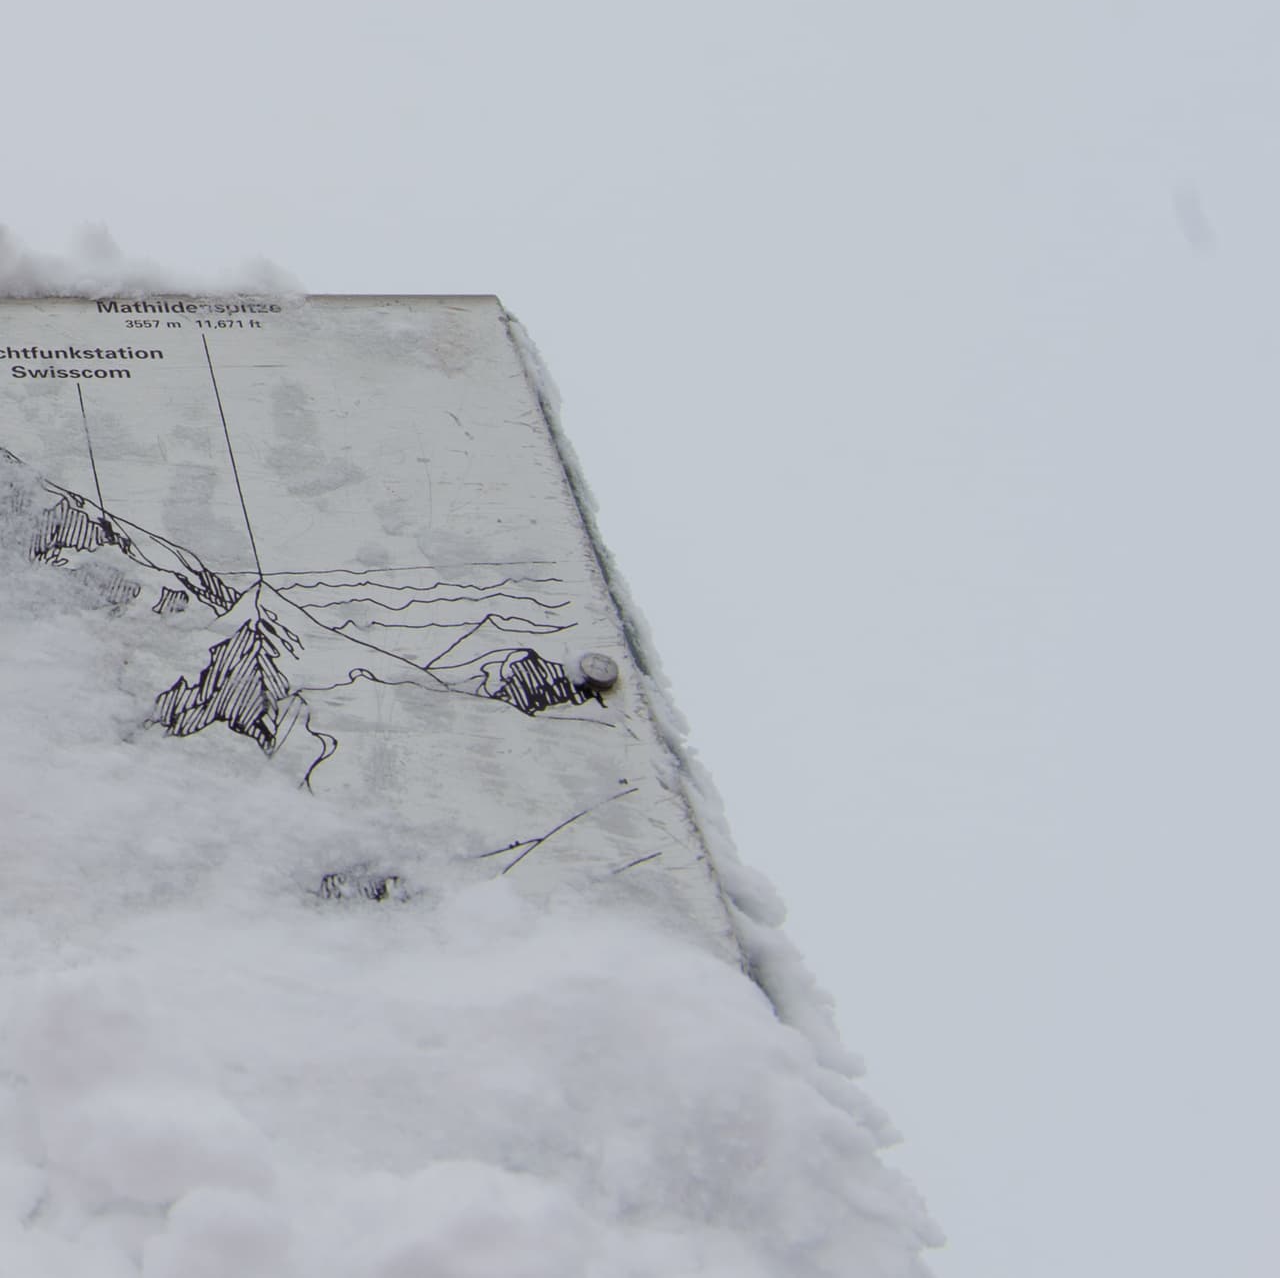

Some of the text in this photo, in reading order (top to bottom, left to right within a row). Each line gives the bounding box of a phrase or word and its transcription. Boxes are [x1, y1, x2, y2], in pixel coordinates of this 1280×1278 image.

[126, 320, 160, 328] 3557
[196, 320, 242, 329] 11,671
[249, 320, 261, 328] ft
[11, 366, 131, 378] Swisscom
